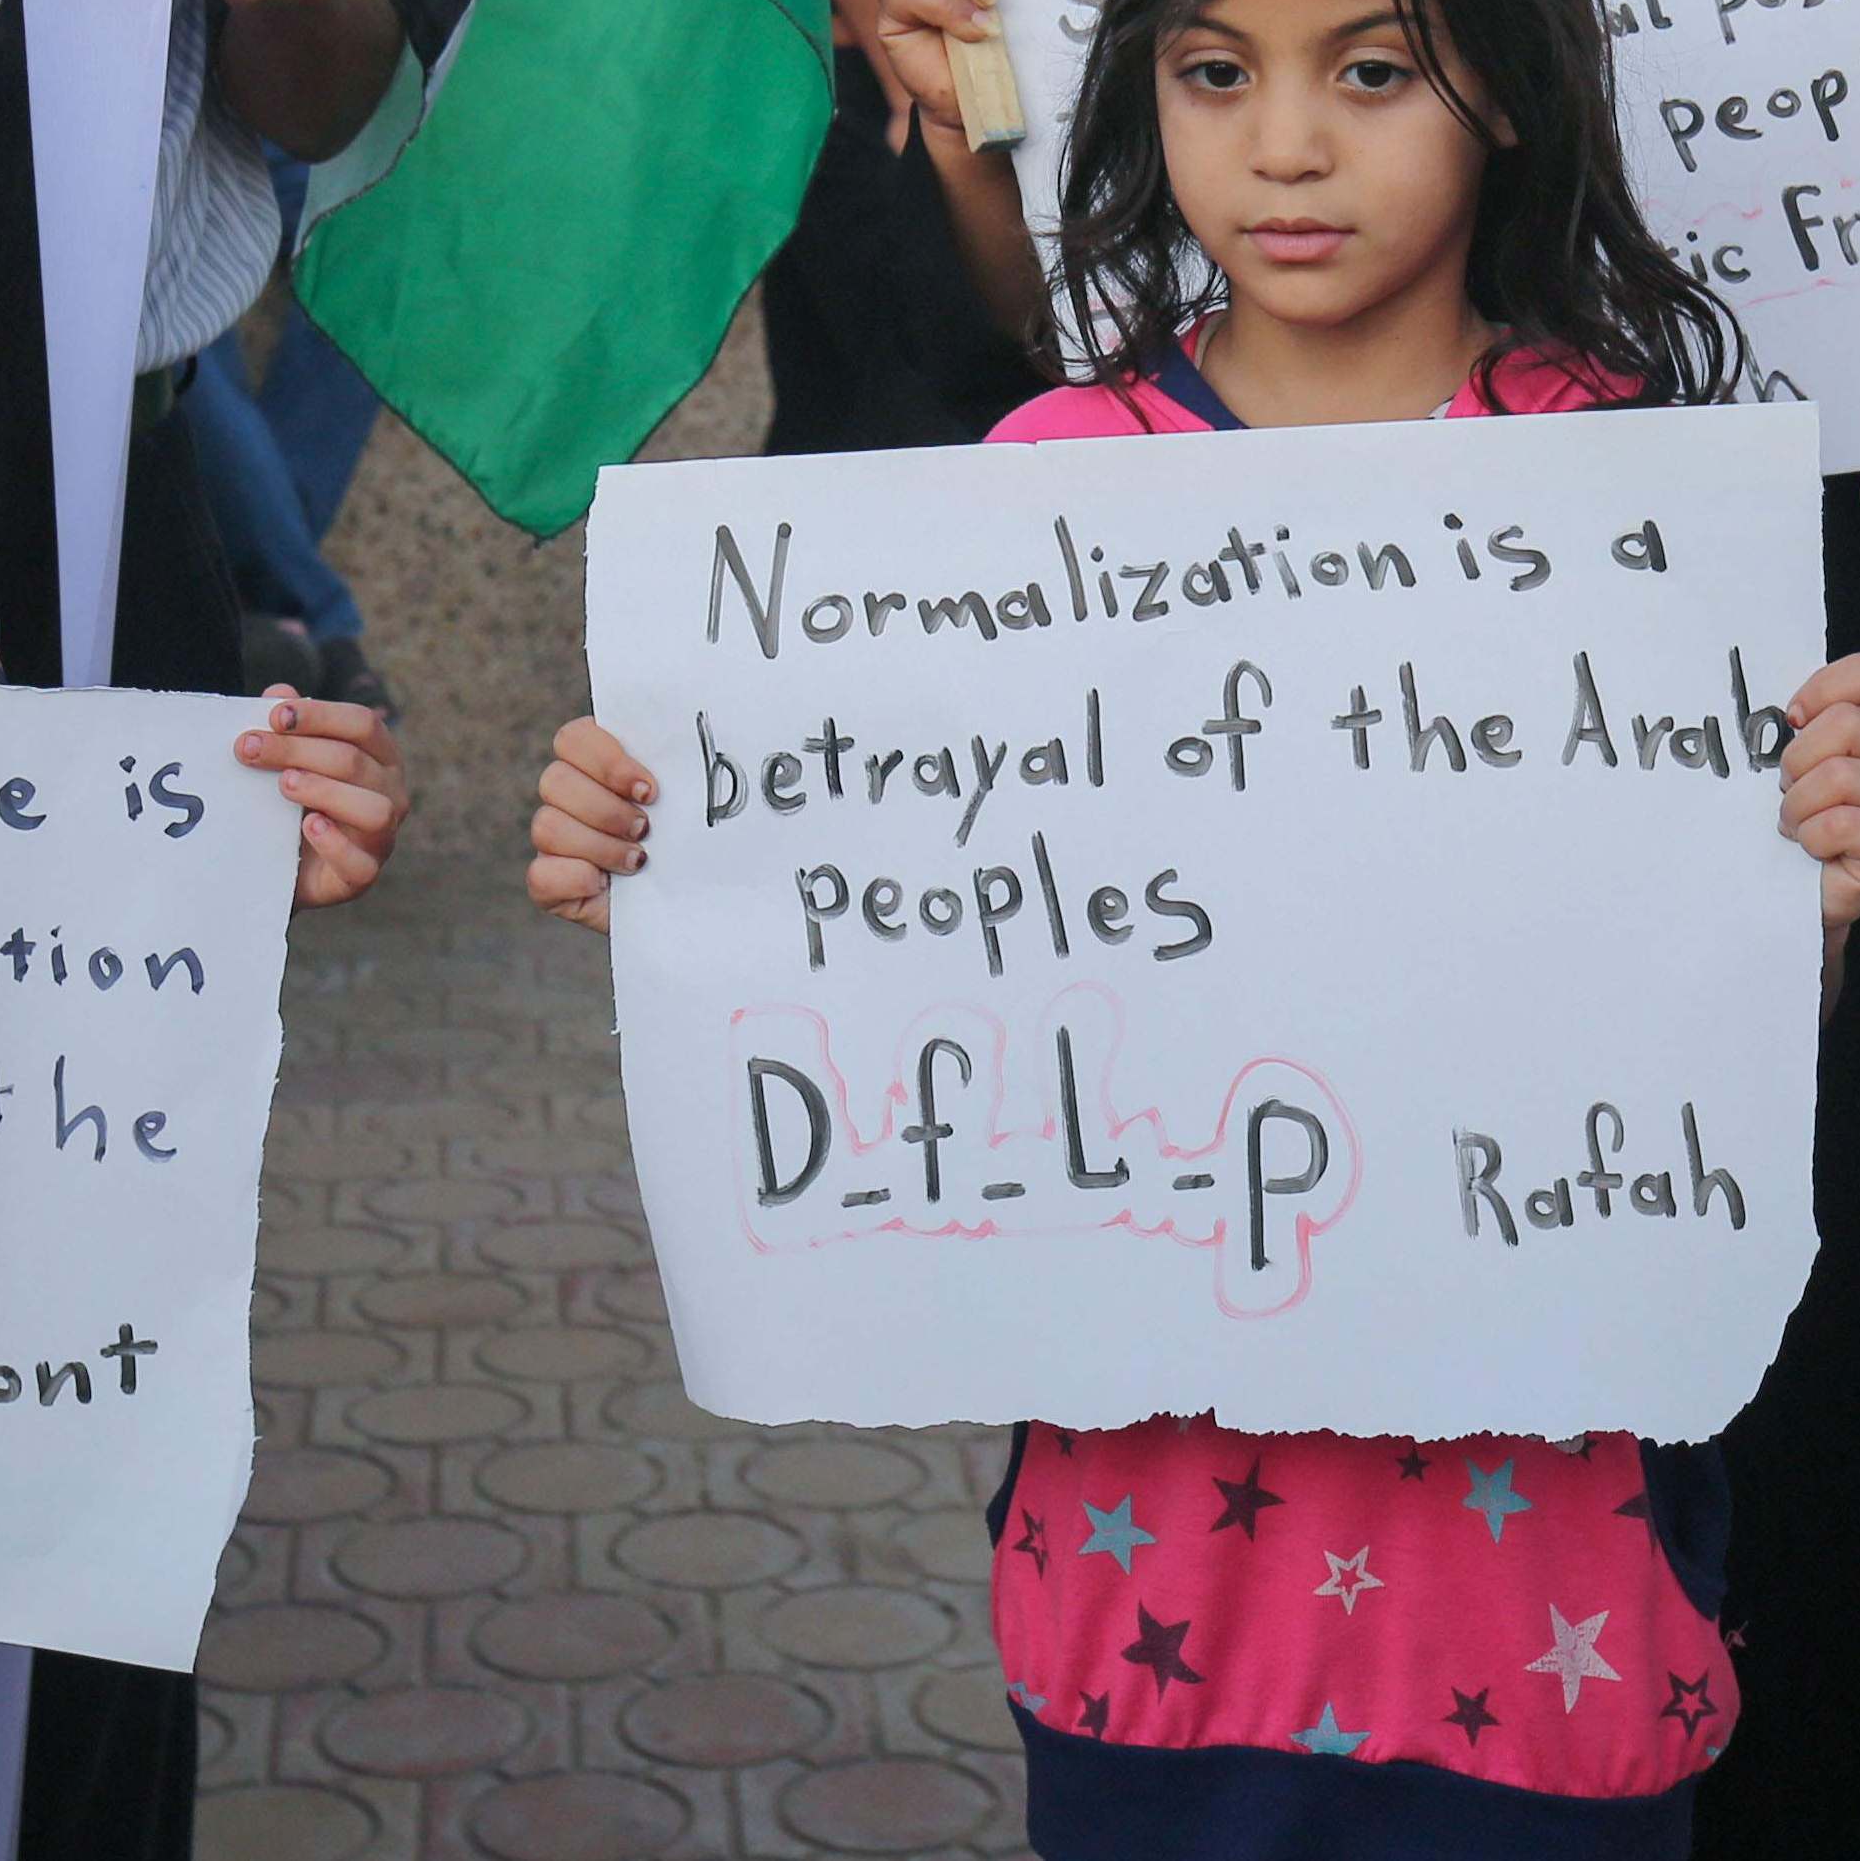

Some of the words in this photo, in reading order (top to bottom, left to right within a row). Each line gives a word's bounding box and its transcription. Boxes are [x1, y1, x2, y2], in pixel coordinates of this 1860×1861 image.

[707, 515, 1417, 659] Normalization
[1443, 513, 1551, 592] is
[1611, 520, 1667, 573] a
[119, 756, 204, 839] is
[696, 688, 1104, 848] betrayal
[1164, 659, 1272, 792] of
[1331, 661, 1522, 772] the
[1561, 645, 1796, 780] Arab
[795, 831, 1212, 978] peoples
[1452, 1102, 1746, 1248] Rafah
